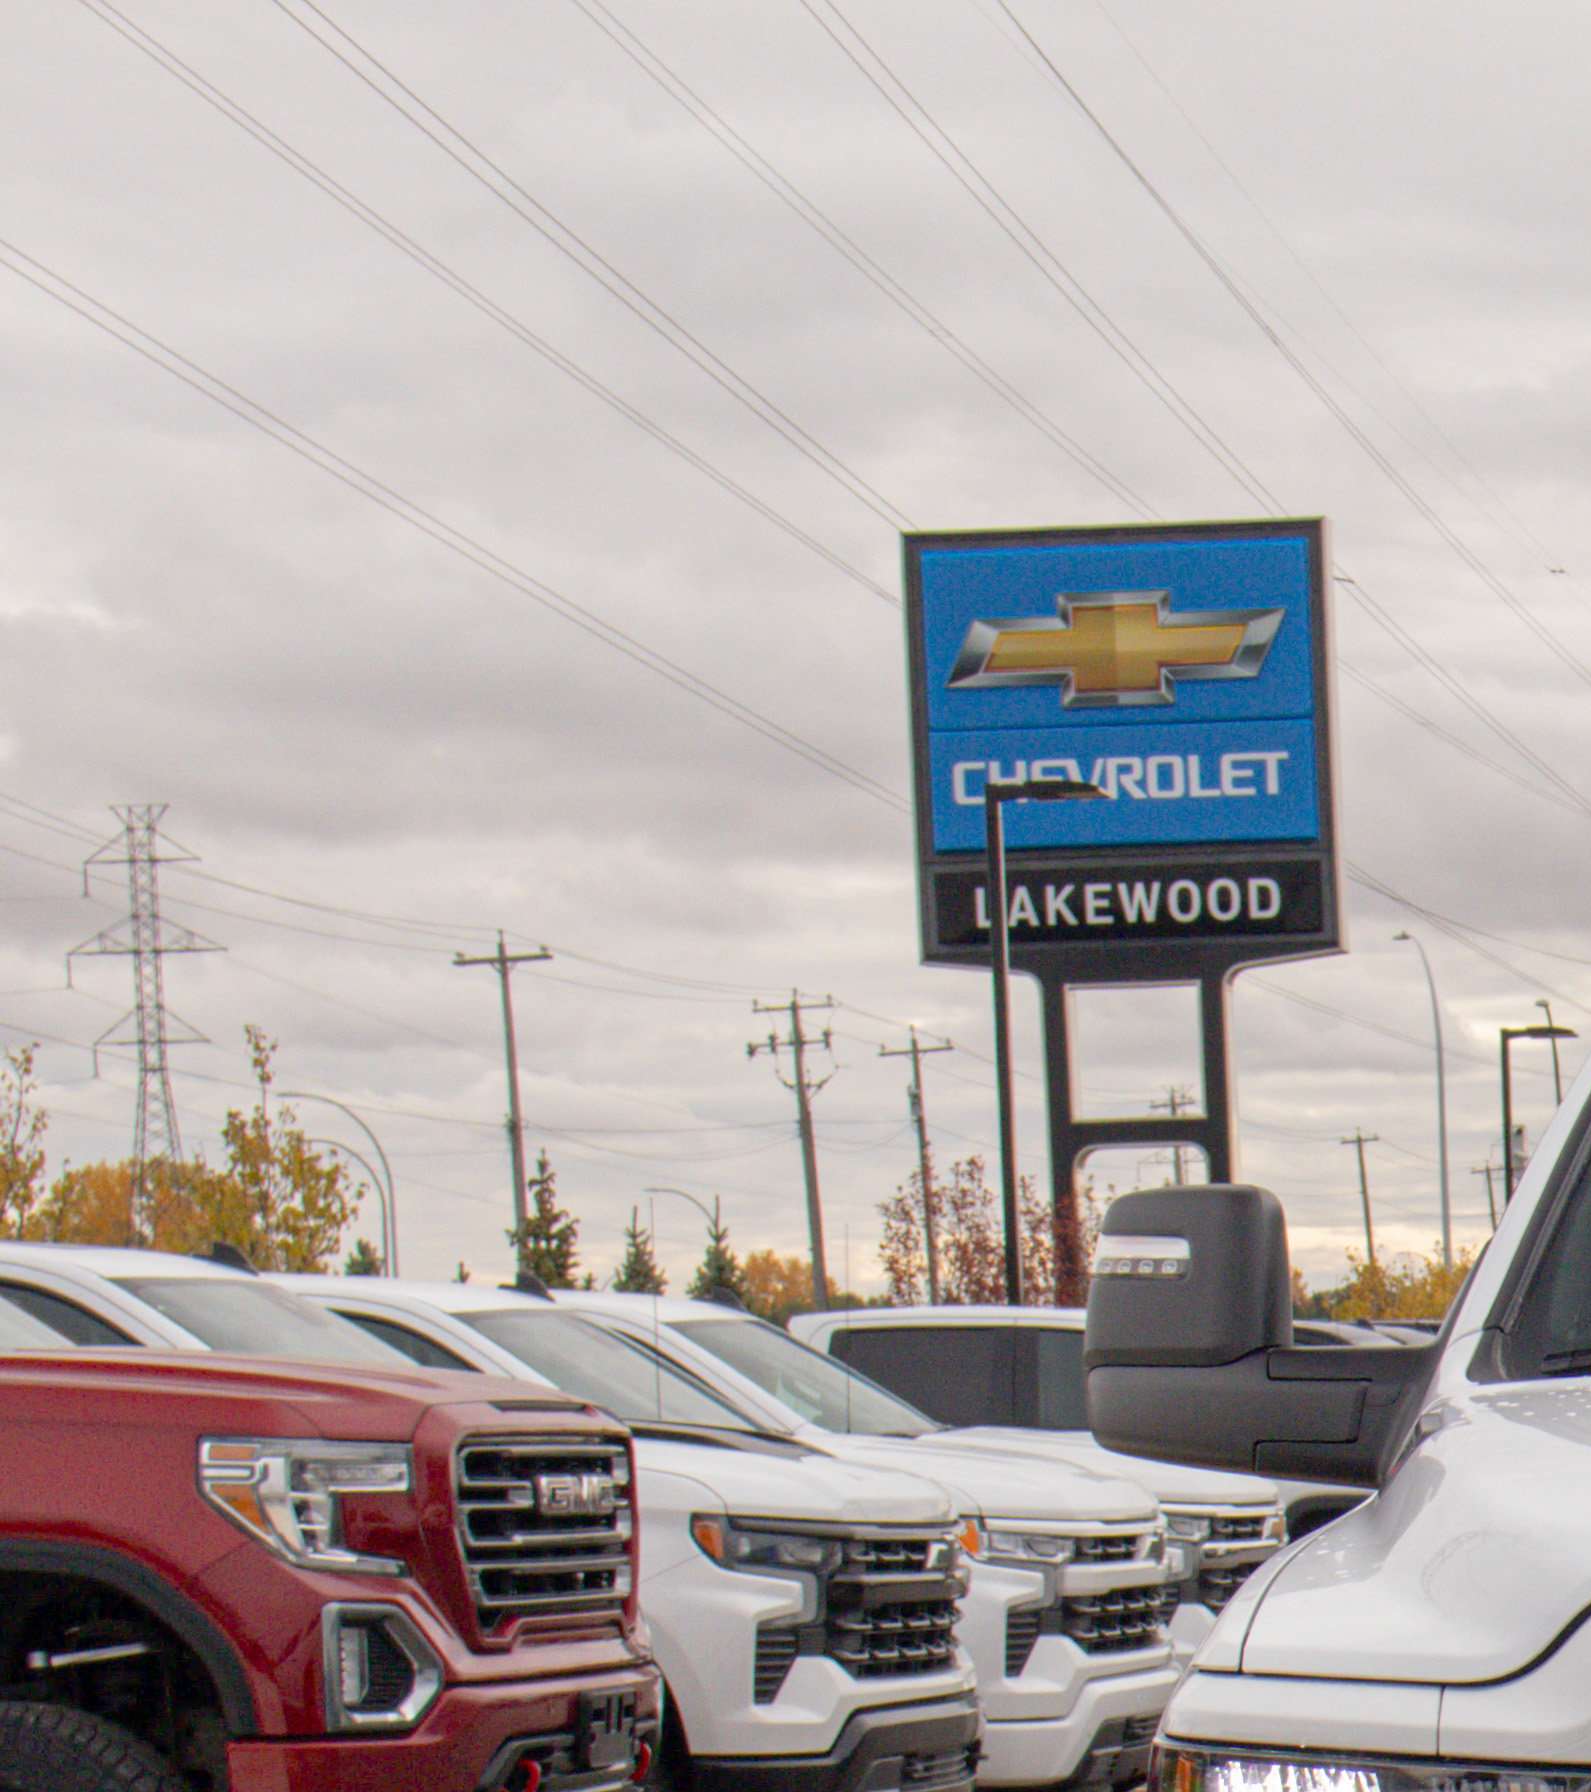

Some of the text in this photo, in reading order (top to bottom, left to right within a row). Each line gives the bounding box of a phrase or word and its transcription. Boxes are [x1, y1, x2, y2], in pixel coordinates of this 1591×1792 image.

[952, 751, 1289, 806] CHEVROLET
[974, 877, 1282, 929] LAKEWOOD
[538, 1473, 615, 1514] GMC
